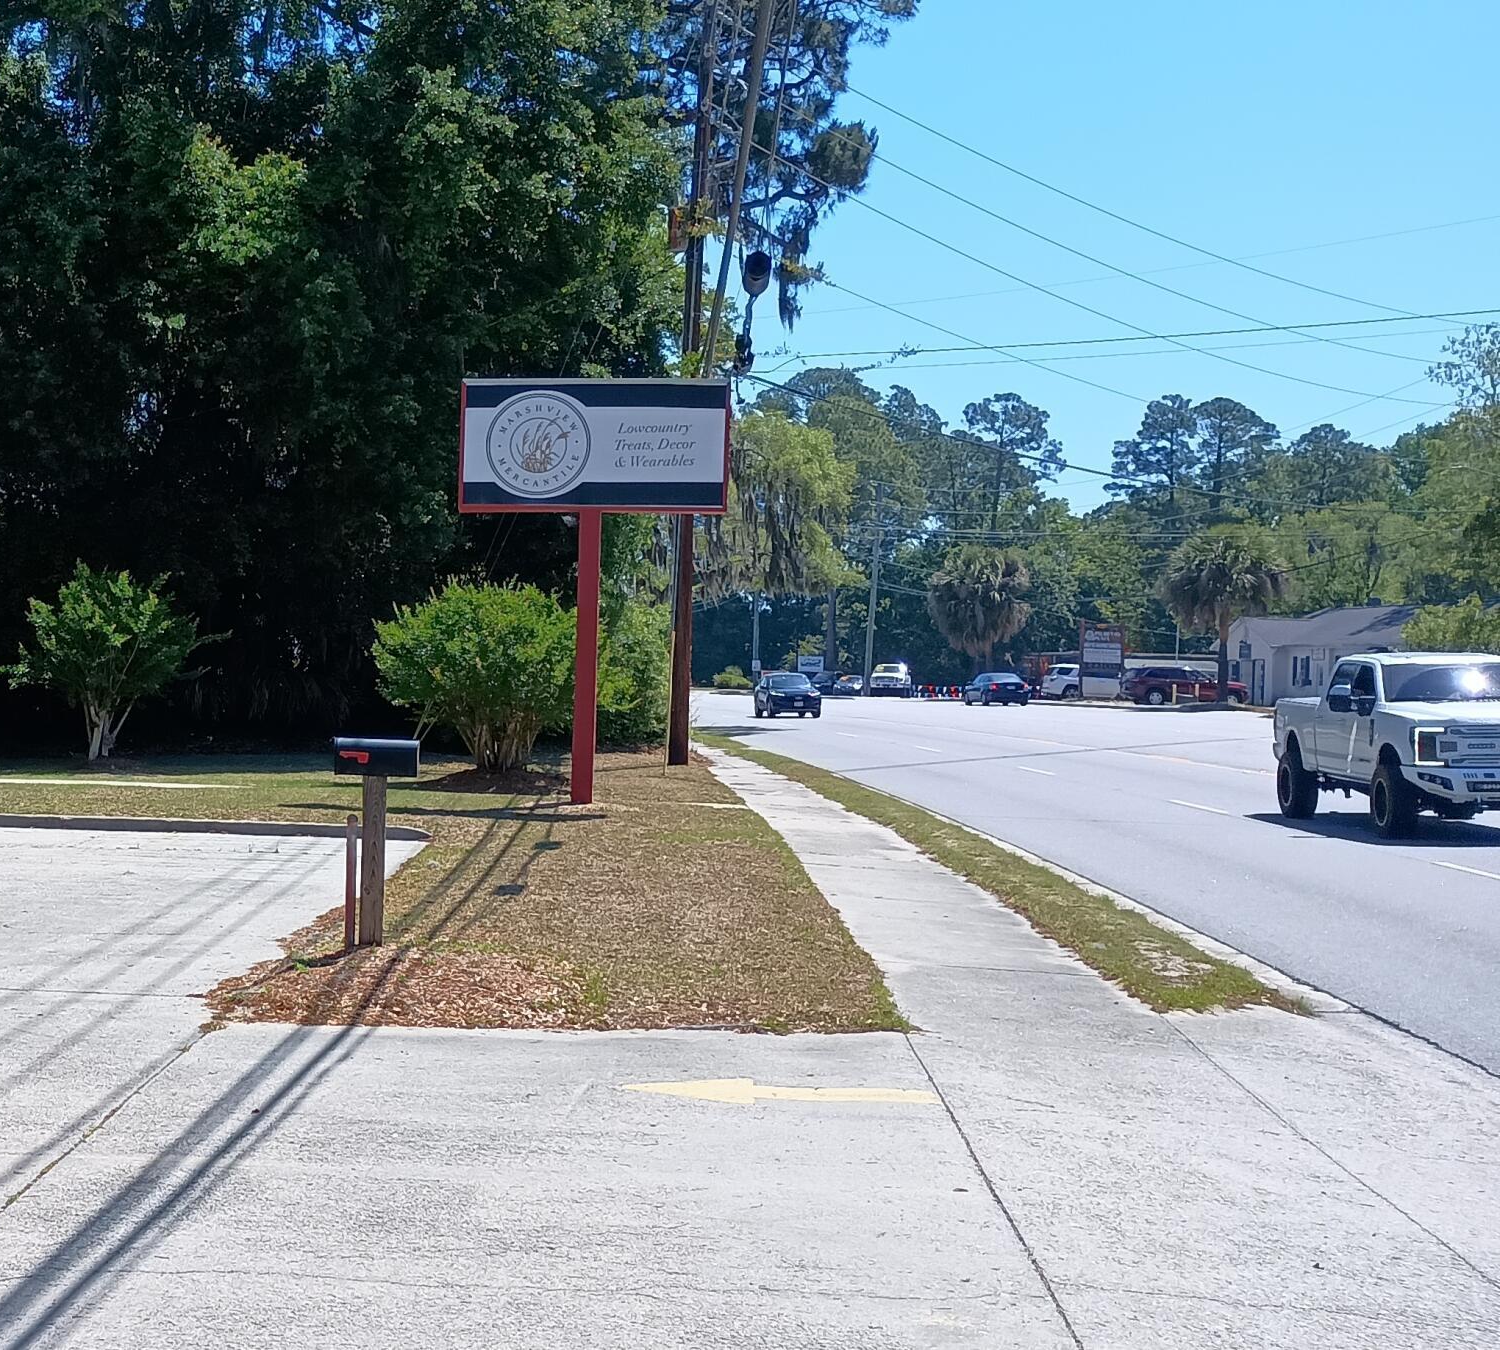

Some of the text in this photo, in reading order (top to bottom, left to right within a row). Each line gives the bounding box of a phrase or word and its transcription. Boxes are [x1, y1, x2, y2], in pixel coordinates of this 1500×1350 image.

[499, 404, 579, 434] MARSHVIEW
[617, 422, 692, 436] Lowcountry
[614, 438, 696, 452] Treats, Decor
[614, 454, 696, 468] & Wearables
[498, 455, 579, 487] MERCANTILE
